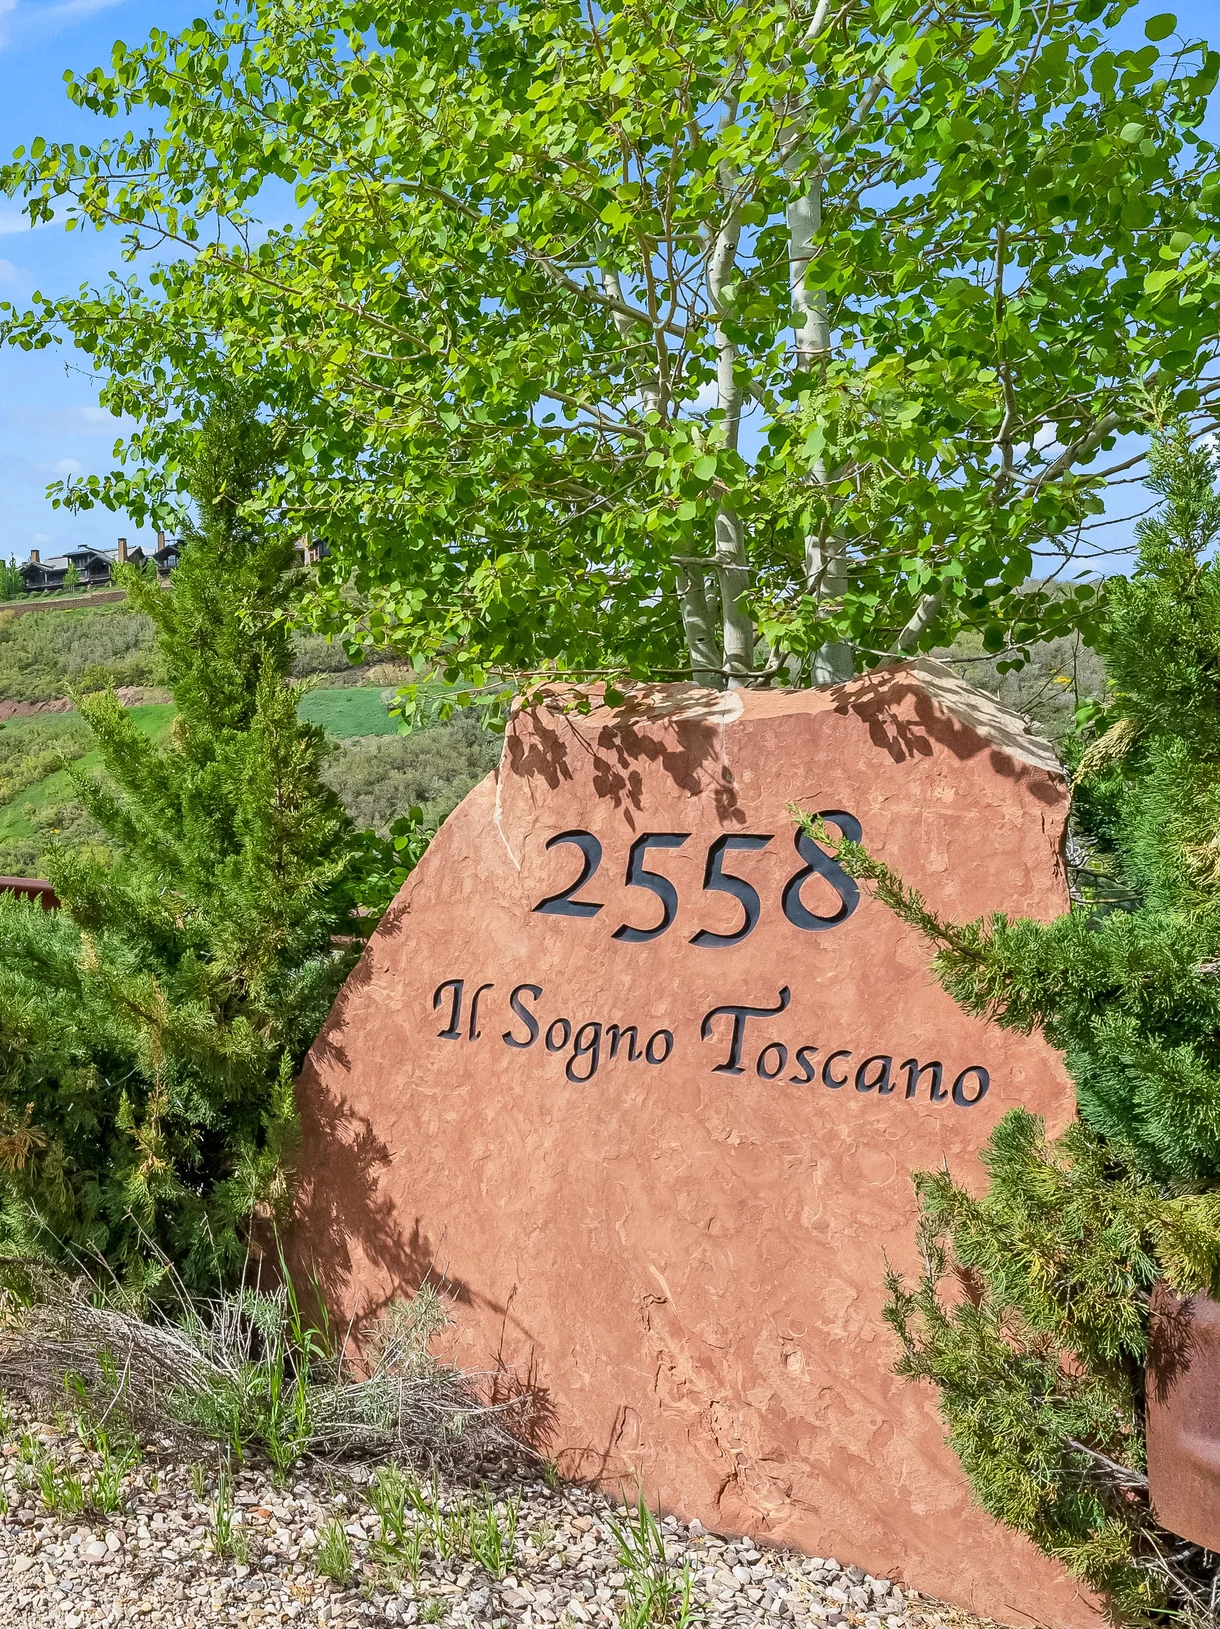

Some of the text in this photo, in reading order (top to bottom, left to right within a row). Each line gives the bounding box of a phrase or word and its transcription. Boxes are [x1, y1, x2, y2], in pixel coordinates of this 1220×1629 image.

[530, 809, 863, 948] 2558
[433, 978, 990, 1107] Il Sogno Toscano
